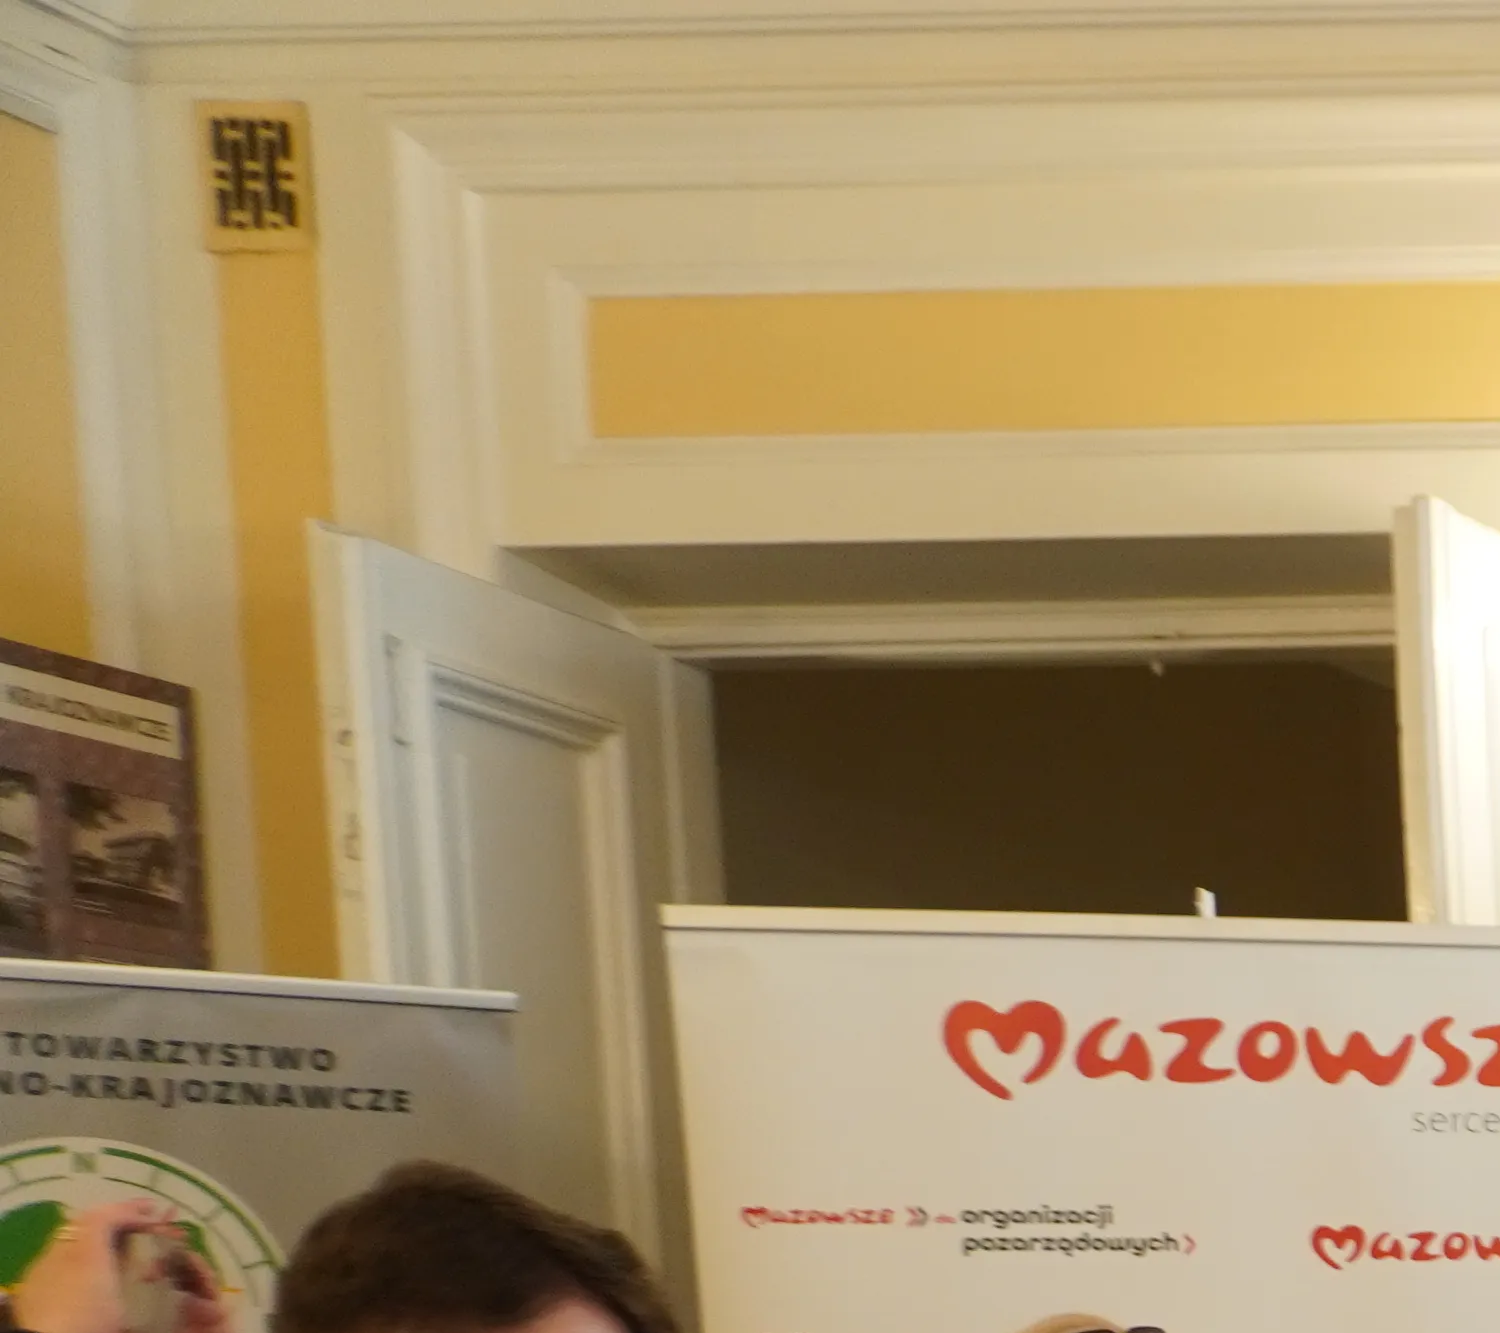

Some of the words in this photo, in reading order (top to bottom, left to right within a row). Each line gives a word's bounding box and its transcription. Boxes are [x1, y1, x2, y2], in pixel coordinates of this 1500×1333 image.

[2, 1030, 338, 1073] TOWARZYSTWO
[1411, 1108, 1500, 1135] serce
[959, 1204, 1114, 1229] organizacji
[962, 1232, 1181, 1257] pozarządowych
